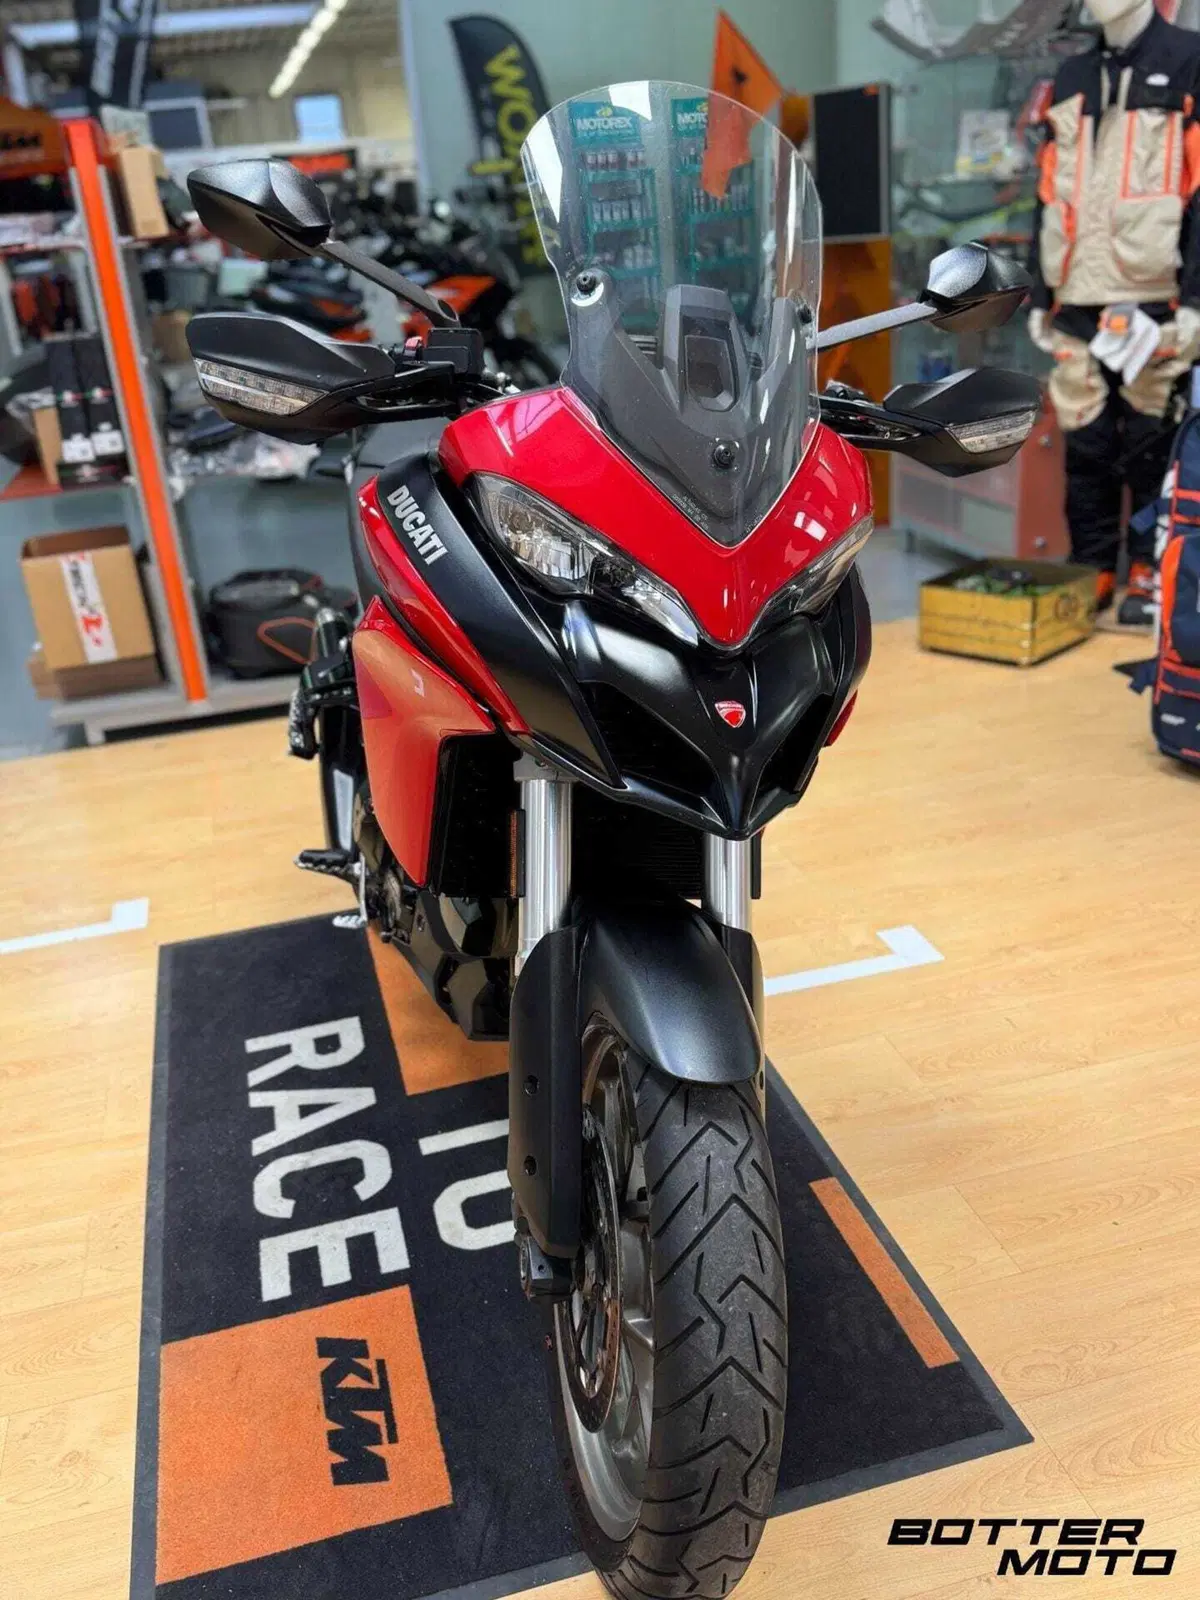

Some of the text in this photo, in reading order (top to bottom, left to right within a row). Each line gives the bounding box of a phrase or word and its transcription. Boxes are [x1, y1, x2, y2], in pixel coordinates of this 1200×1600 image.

[386, 485, 449, 566] DUCATI
[245, 1016, 410, 1302] RACE
[316, 1336, 399, 1486] KTM
